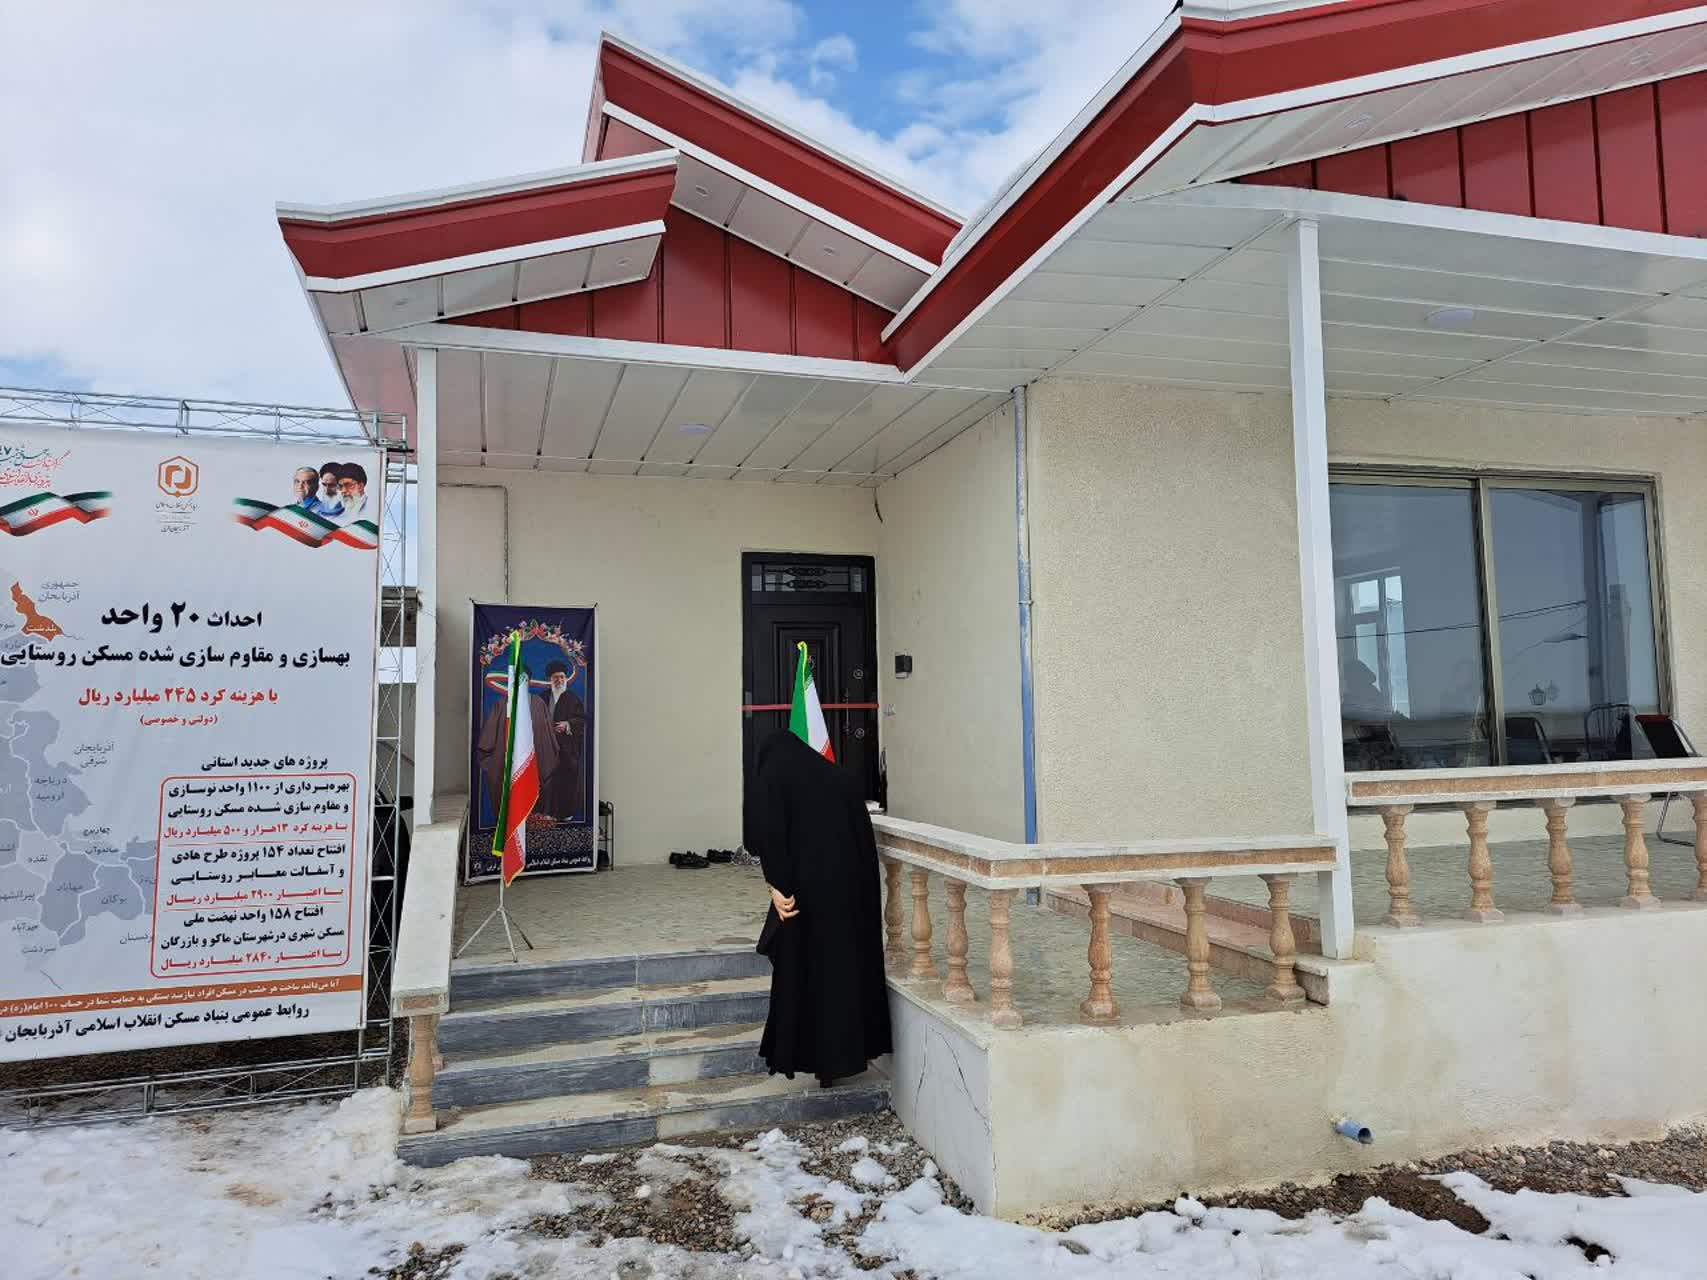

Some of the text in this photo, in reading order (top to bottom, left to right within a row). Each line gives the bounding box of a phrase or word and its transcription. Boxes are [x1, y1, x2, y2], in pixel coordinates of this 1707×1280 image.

[41, 581, 79, 590] جمهوری
[38, 592, 80, 603] آذربایجان
[101, 601, 262, 633] احداث ۲۰ واحد
[1, 644, 76, 667] روستایی
[82, 644, 133, 667] مسکن
[139, 645, 174, 662] شده
[179, 646, 225, 668] سازی
[230, 646, 274, 668] مقاوم
[278, 653, 288, 668] و
[292, 647, 350, 668] بهسازی
[78, 687, 278, 706] با هزینه کرد ۲۴۵ میلیارد ریال
[74, 741, 114, 755] آذربایجان
[80, 756, 107, 768] شرقی
[201, 755, 328, 771] پروژه های جدید استانی
[169, 782, 216, 797] نوسازی
[218, 782, 244, 796] واحد
[248, 782, 270, 793] ۱۱۰۰
[274, 782, 284, 795] از
[167, 801, 349, 818] و مقاوم سازی شده مسکن روستایی
[164, 827, 183, 838] ریال
[185, 826, 222, 838] میلیارد
[293, 823, 309, 833] کرد
[311, 824, 332, 832] هزینه
[172, 844, 346, 864] افتتاح تعداد ۱۵۴ پروژه طرح هادی
[236, 868, 287, 882] معابر
[290, 863, 335, 877] آسفالت
[339, 868, 345, 878] و
[171, 870, 232, 885] روستایی
[166, 895, 202, 906] ریال
[204, 891, 249, 904] میلیارد
[276, 887, 321, 901] اعتبار
[183, 906, 324, 927] افتتاح ۱۵۸ واحد نهضت ملی
[119, 932, 153, 944] ردستان
[210, 933, 231, 947] ماکو
[288, 930, 315, 942] شهری
[317, 927, 345, 940] مسکن
[160, 935, 199, 950] بازرگان
[202, 937, 207, 947] و
[200, 954, 243, 969] میلیارد
[274, 949, 320, 963] اعتبار
[160, 957, 197, 971] ریال
[5, 1003, 309, 1042] روابط عمومی بنیاد مسکن انقلاب اسلامی آذربایجان
